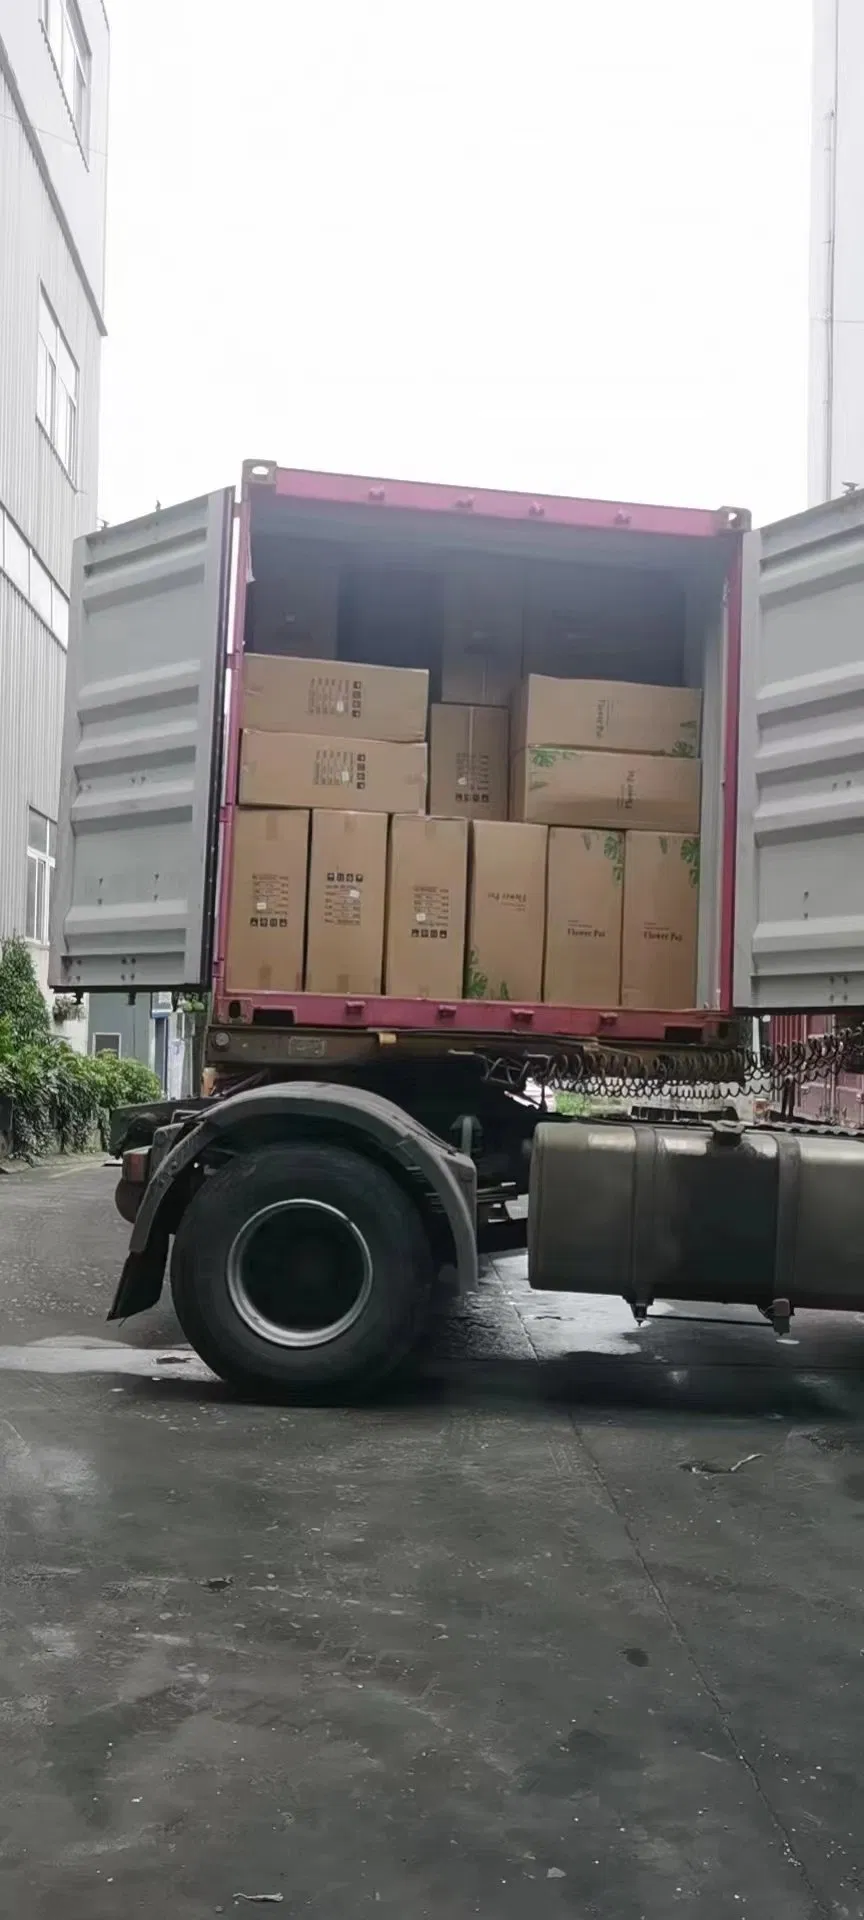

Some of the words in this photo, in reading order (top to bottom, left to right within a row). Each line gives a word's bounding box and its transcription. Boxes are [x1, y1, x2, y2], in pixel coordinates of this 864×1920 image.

[567, 928, 592, 938] Flower
[593, 928, 606, 940] Pot
[644, 931, 669, 941] Flower
[670, 931, 684, 943] Pot
